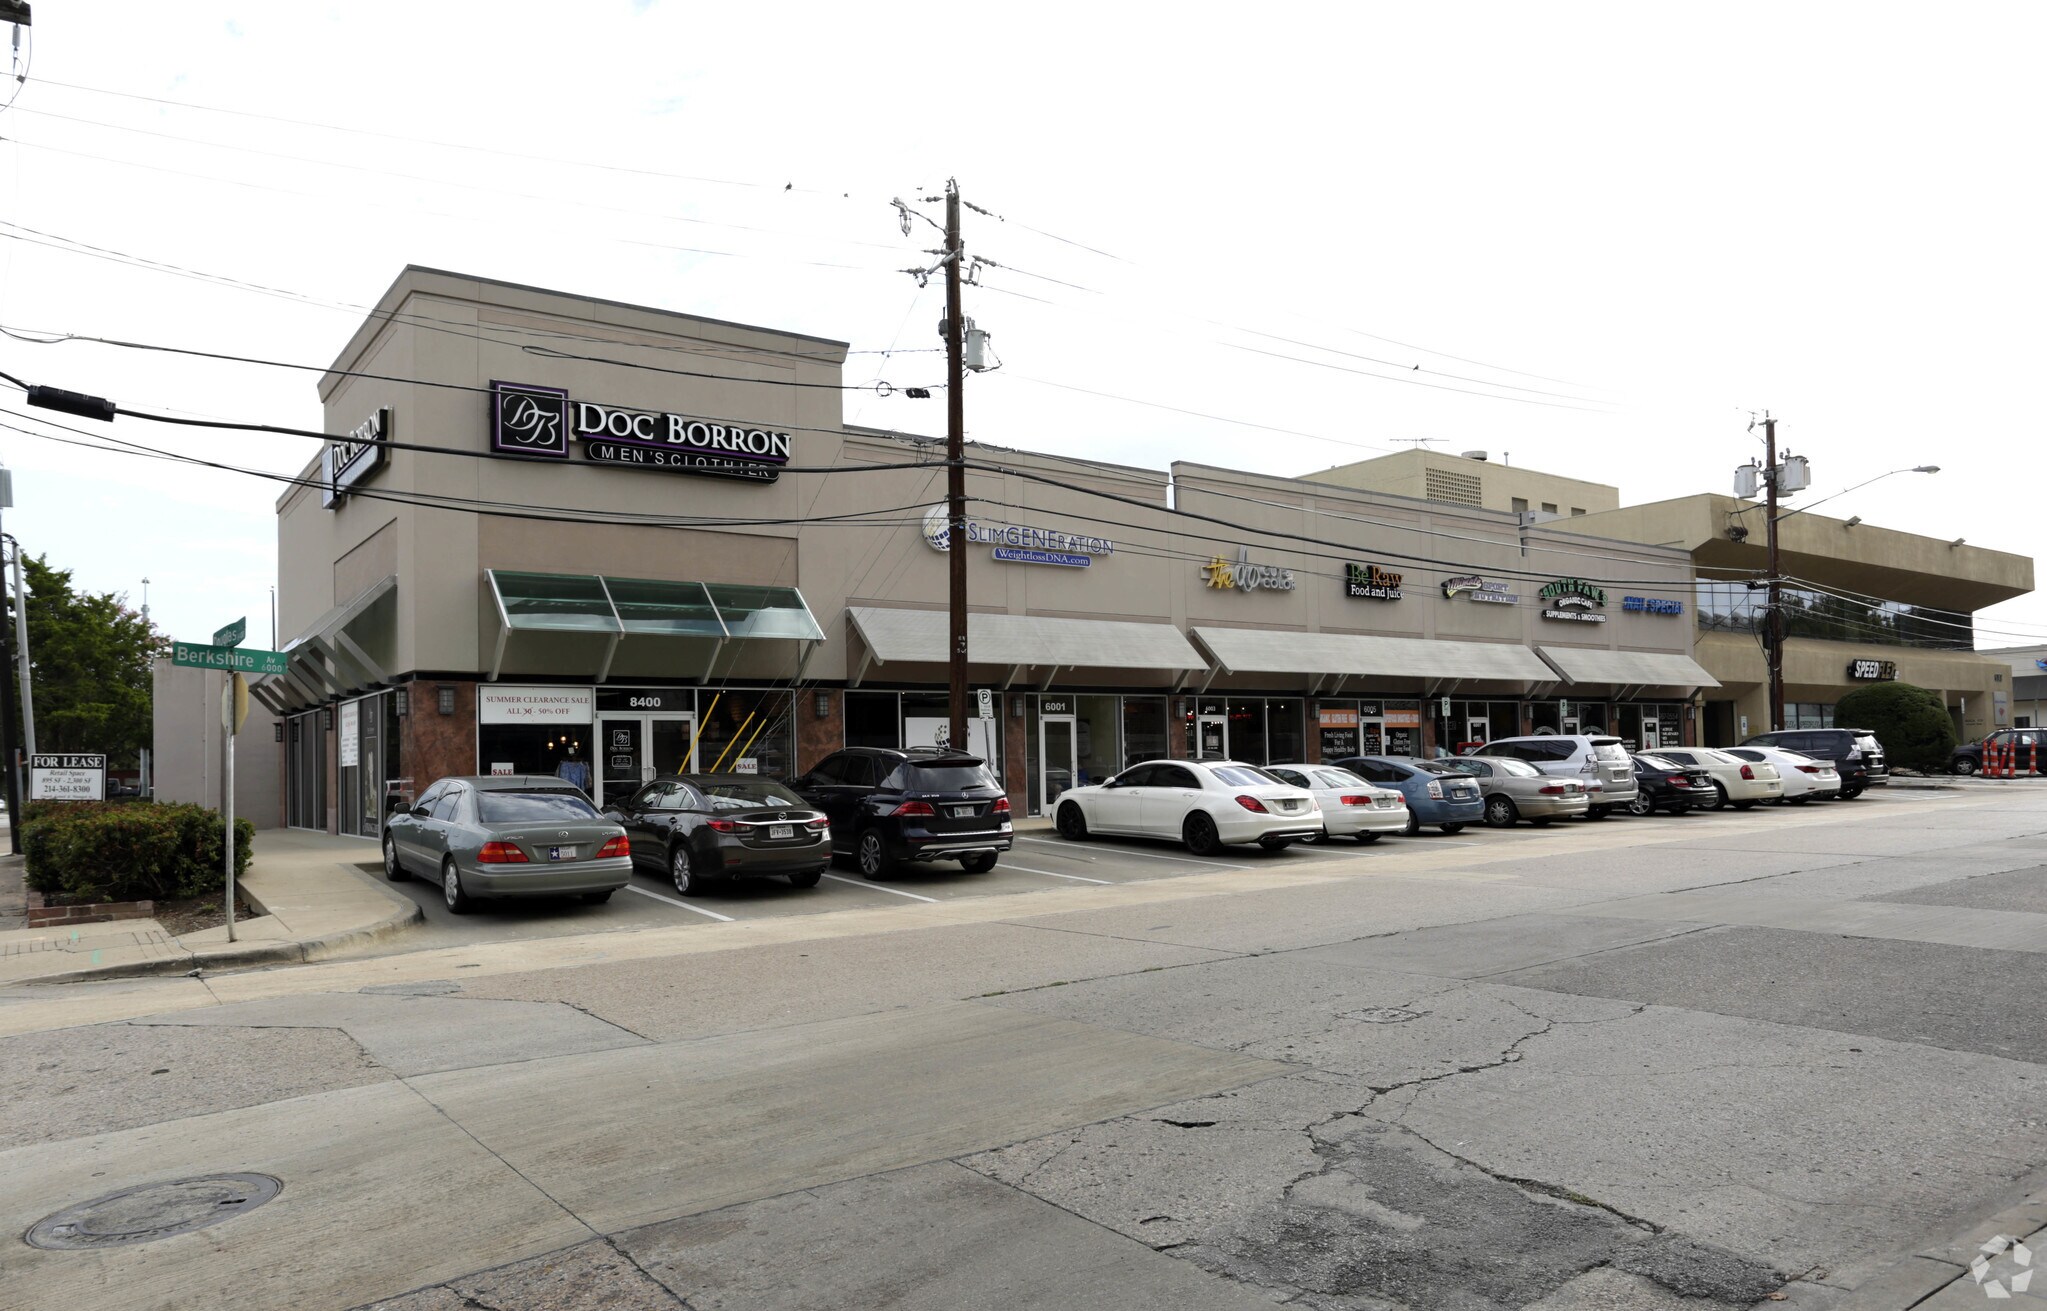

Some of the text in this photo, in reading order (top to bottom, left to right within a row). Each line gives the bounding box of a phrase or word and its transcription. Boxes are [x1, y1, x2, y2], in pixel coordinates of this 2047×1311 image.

[577, 402, 792, 458] DOC BORRON
[601, 446, 665, 465] MEN'S
[999, 549, 1089, 566] WeightlossDNA.com
[1350, 563, 1404, 588] Be Raw
[1263, 577, 1296, 591] COLOR
[1351, 584, 1370, 596] Food
[1371, 586, 1386, 597] and
[177, 646, 254, 668] Berkshire
[266, 656, 276, 664] Av
[261, 664, 283, 673] 6000
[523, 696, 570, 704] CLEARANCE
[630, 697, 661, 707] 8400
[1045, 702, 1066, 711] 6001
[1363, 705, 1377, 713] 6005
[33, 756, 102, 768] FOR LEASE
[44, 785, 91, 793] 214-361-8300
